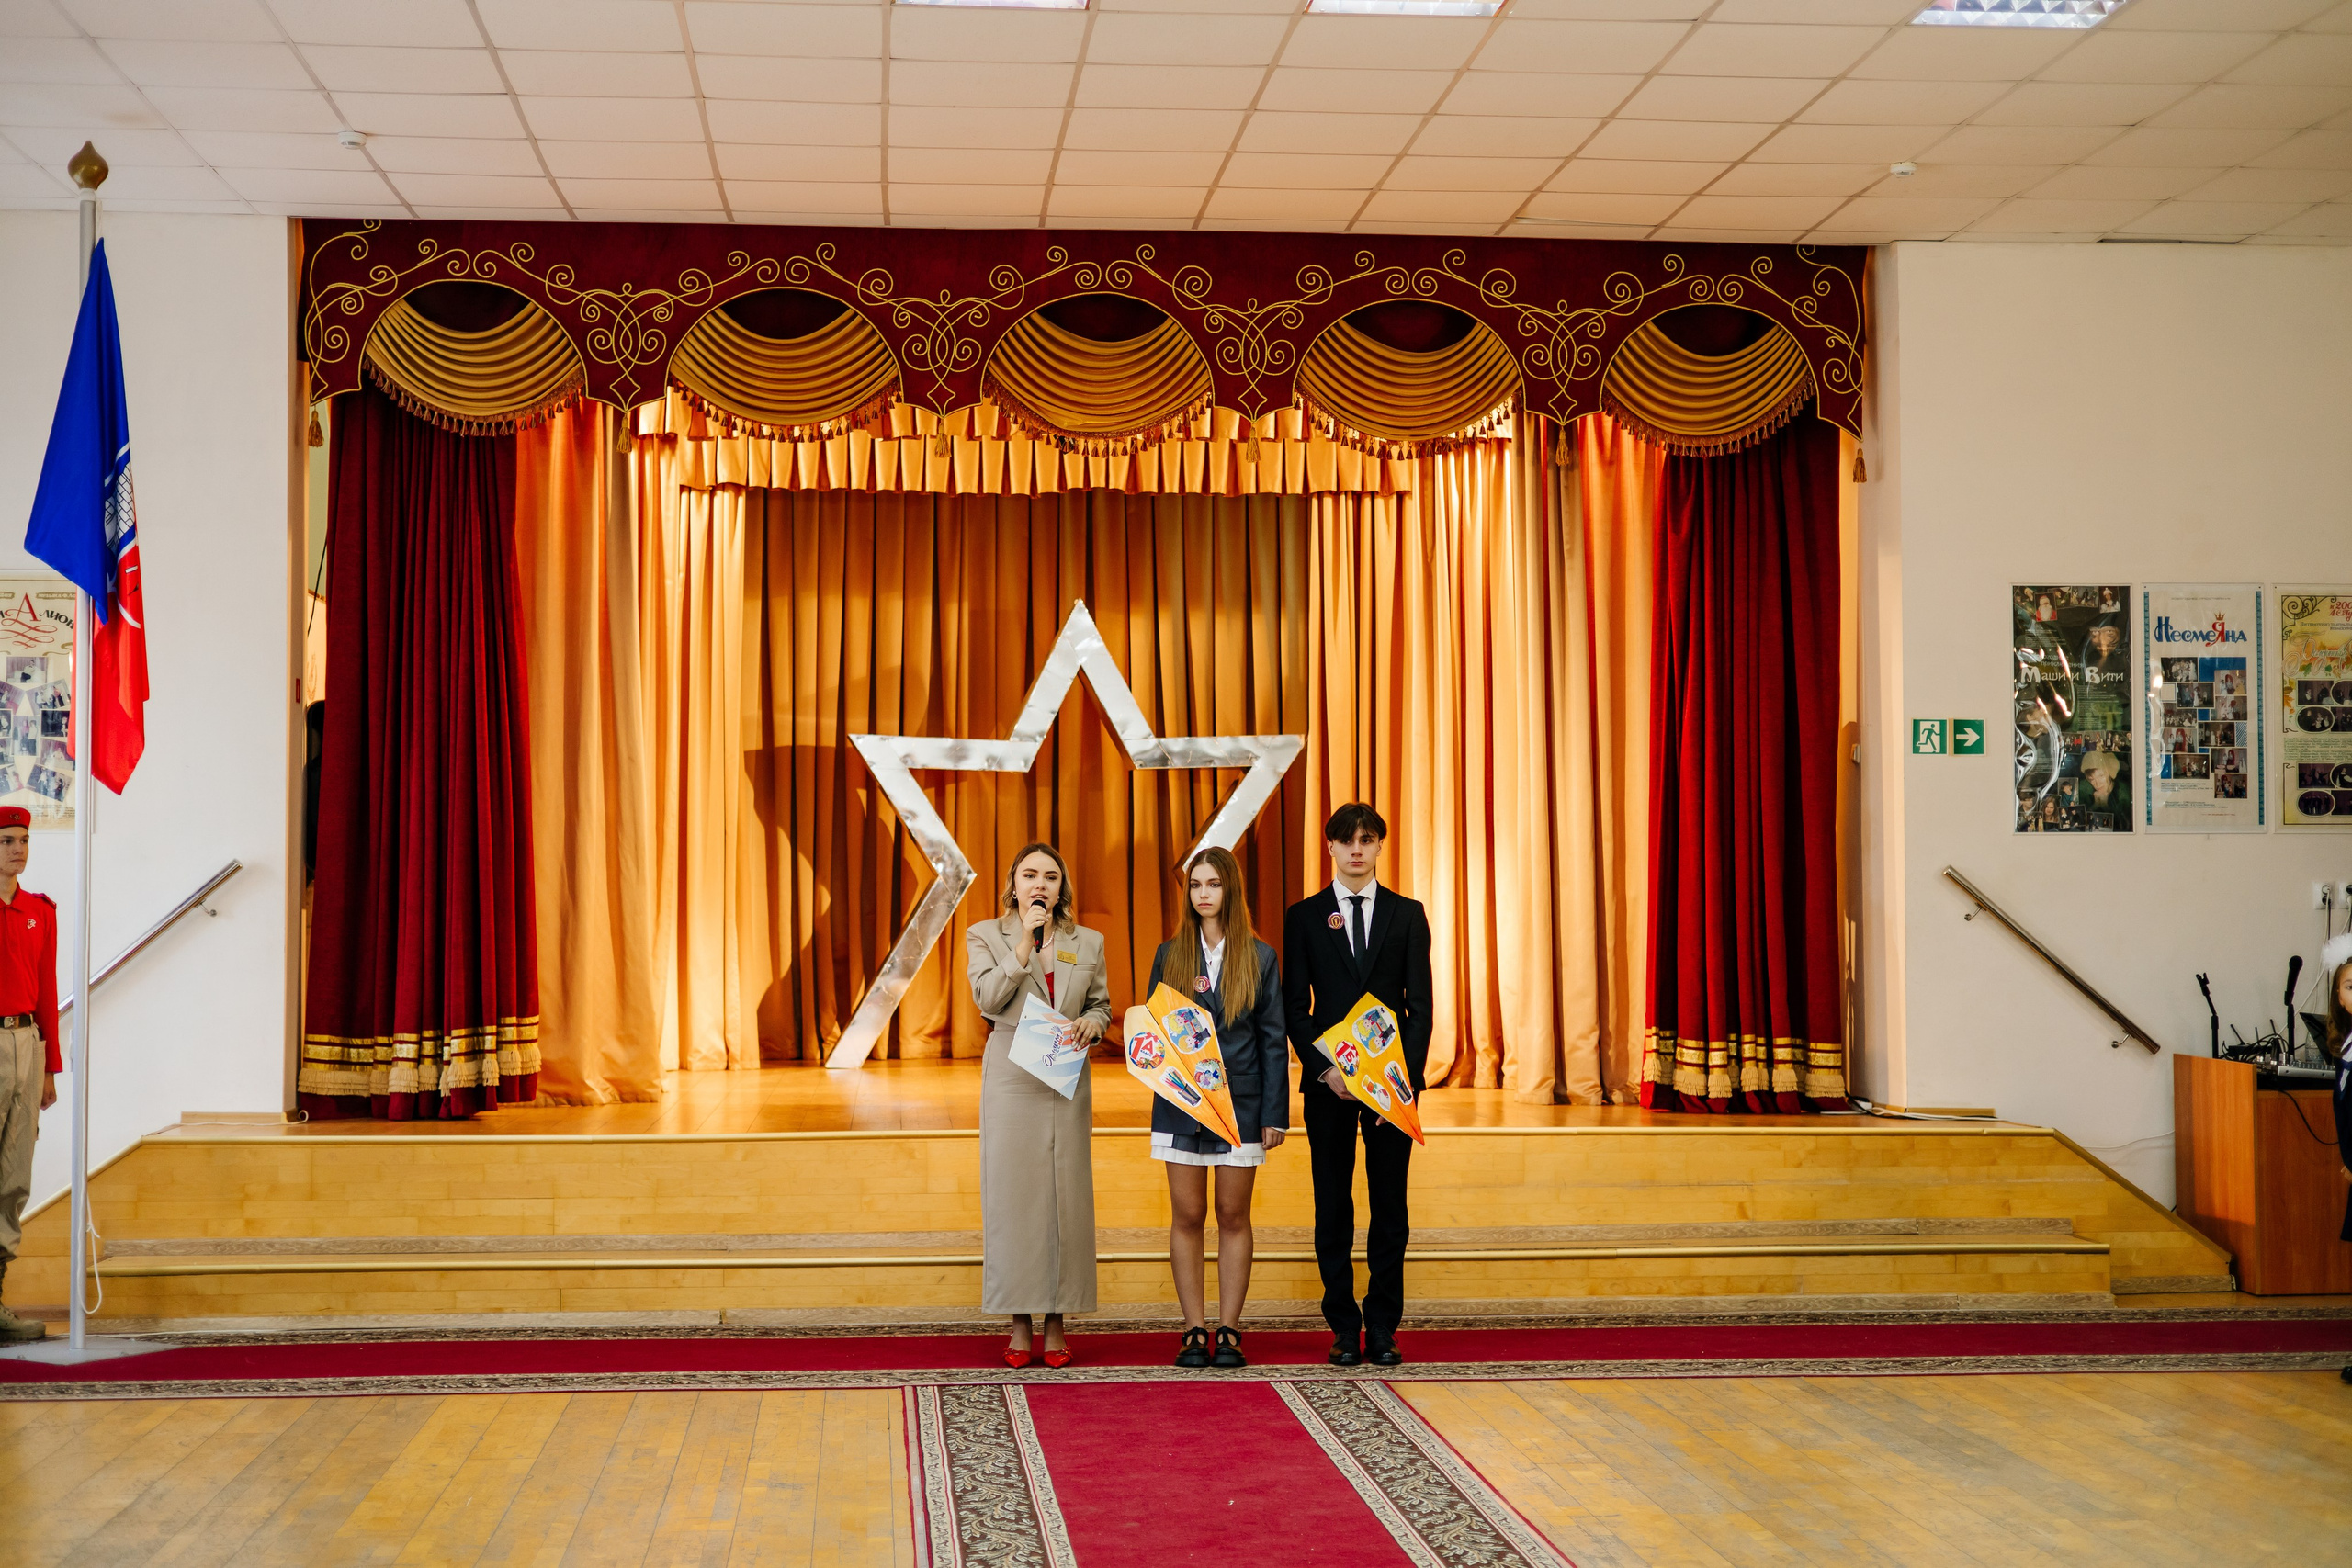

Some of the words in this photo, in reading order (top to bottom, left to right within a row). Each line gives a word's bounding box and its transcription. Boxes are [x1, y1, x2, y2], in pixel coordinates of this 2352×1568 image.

[2021, 666, 2066, 683] Маши
[2071, 672, 2080, 681] и
[2086, 666, 2124, 684] Вити
